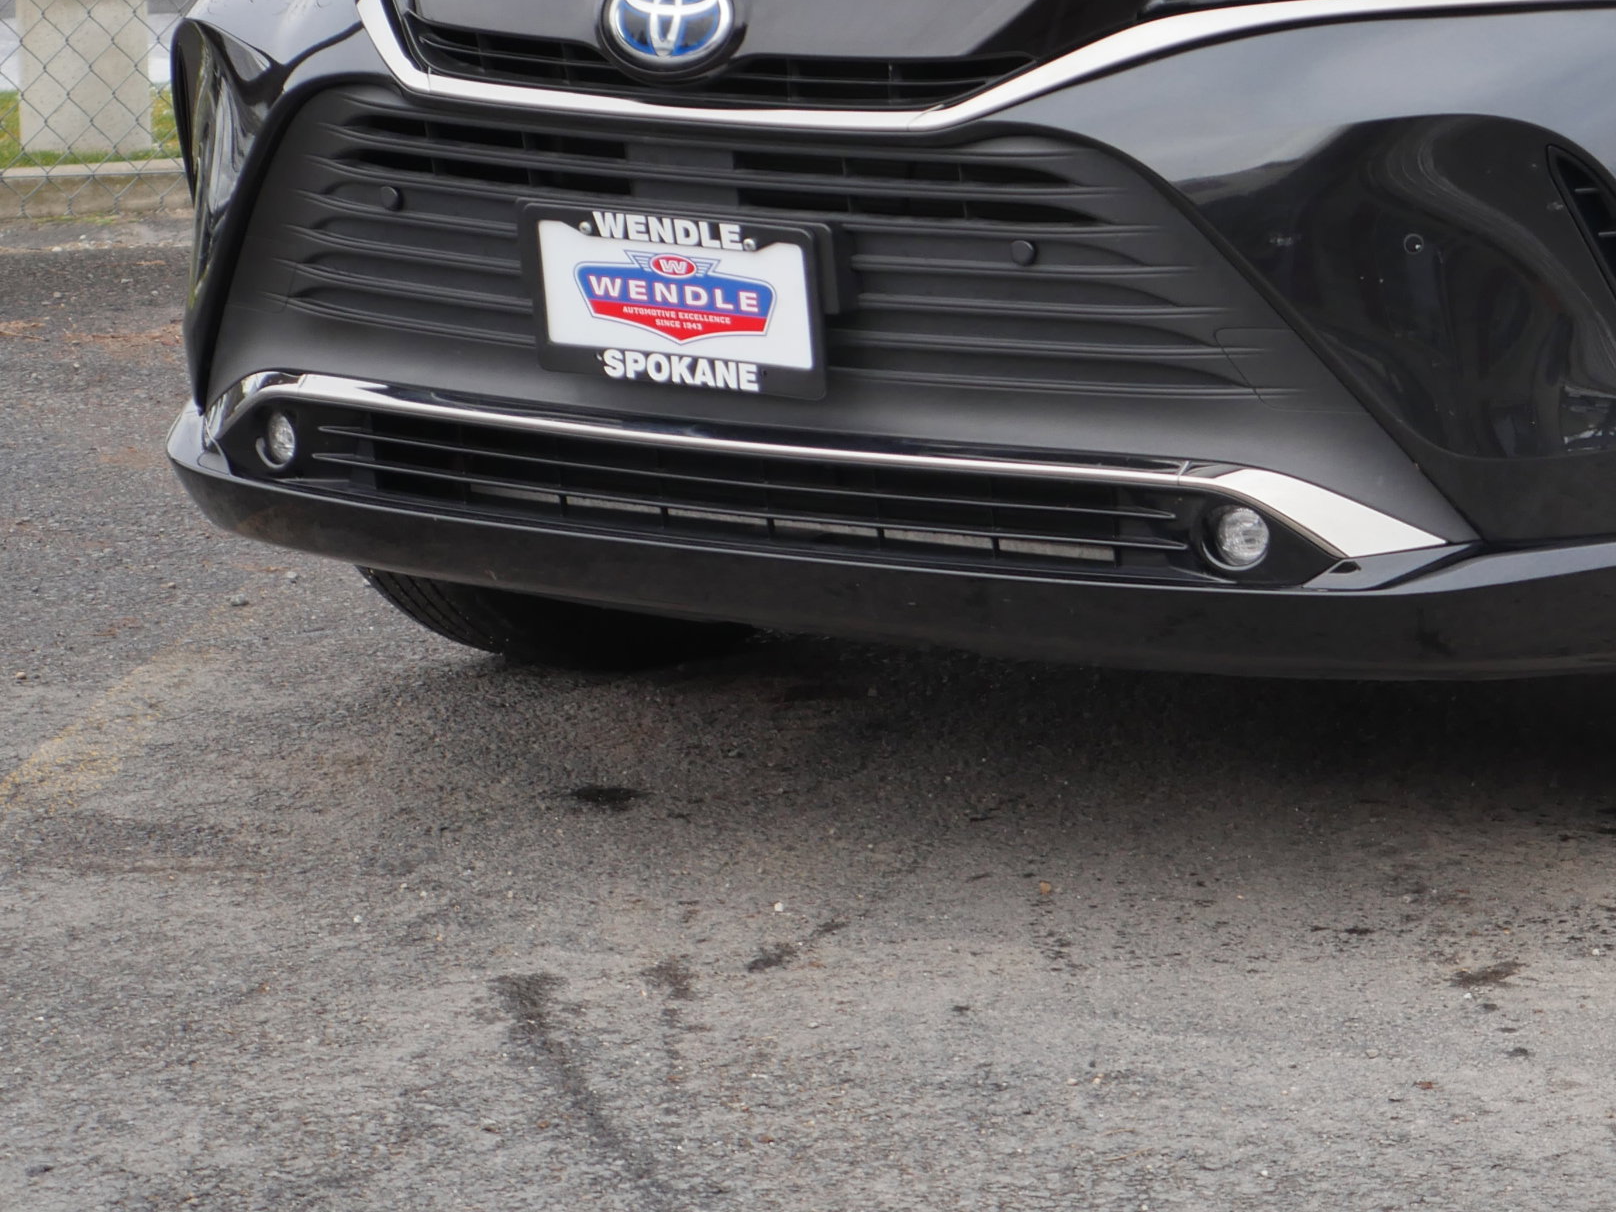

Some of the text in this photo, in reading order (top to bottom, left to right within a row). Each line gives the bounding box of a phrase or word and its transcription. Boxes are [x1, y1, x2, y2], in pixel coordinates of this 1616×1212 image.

[592, 211, 744, 251] WENDLE
[588, 275, 759, 313] WENDLE
[622, 305, 731, 324] AUTOMOTIVE EXCELLENCE
[655, 318, 703, 331] SINCE 1943
[602, 348, 760, 393] SPOKANE
